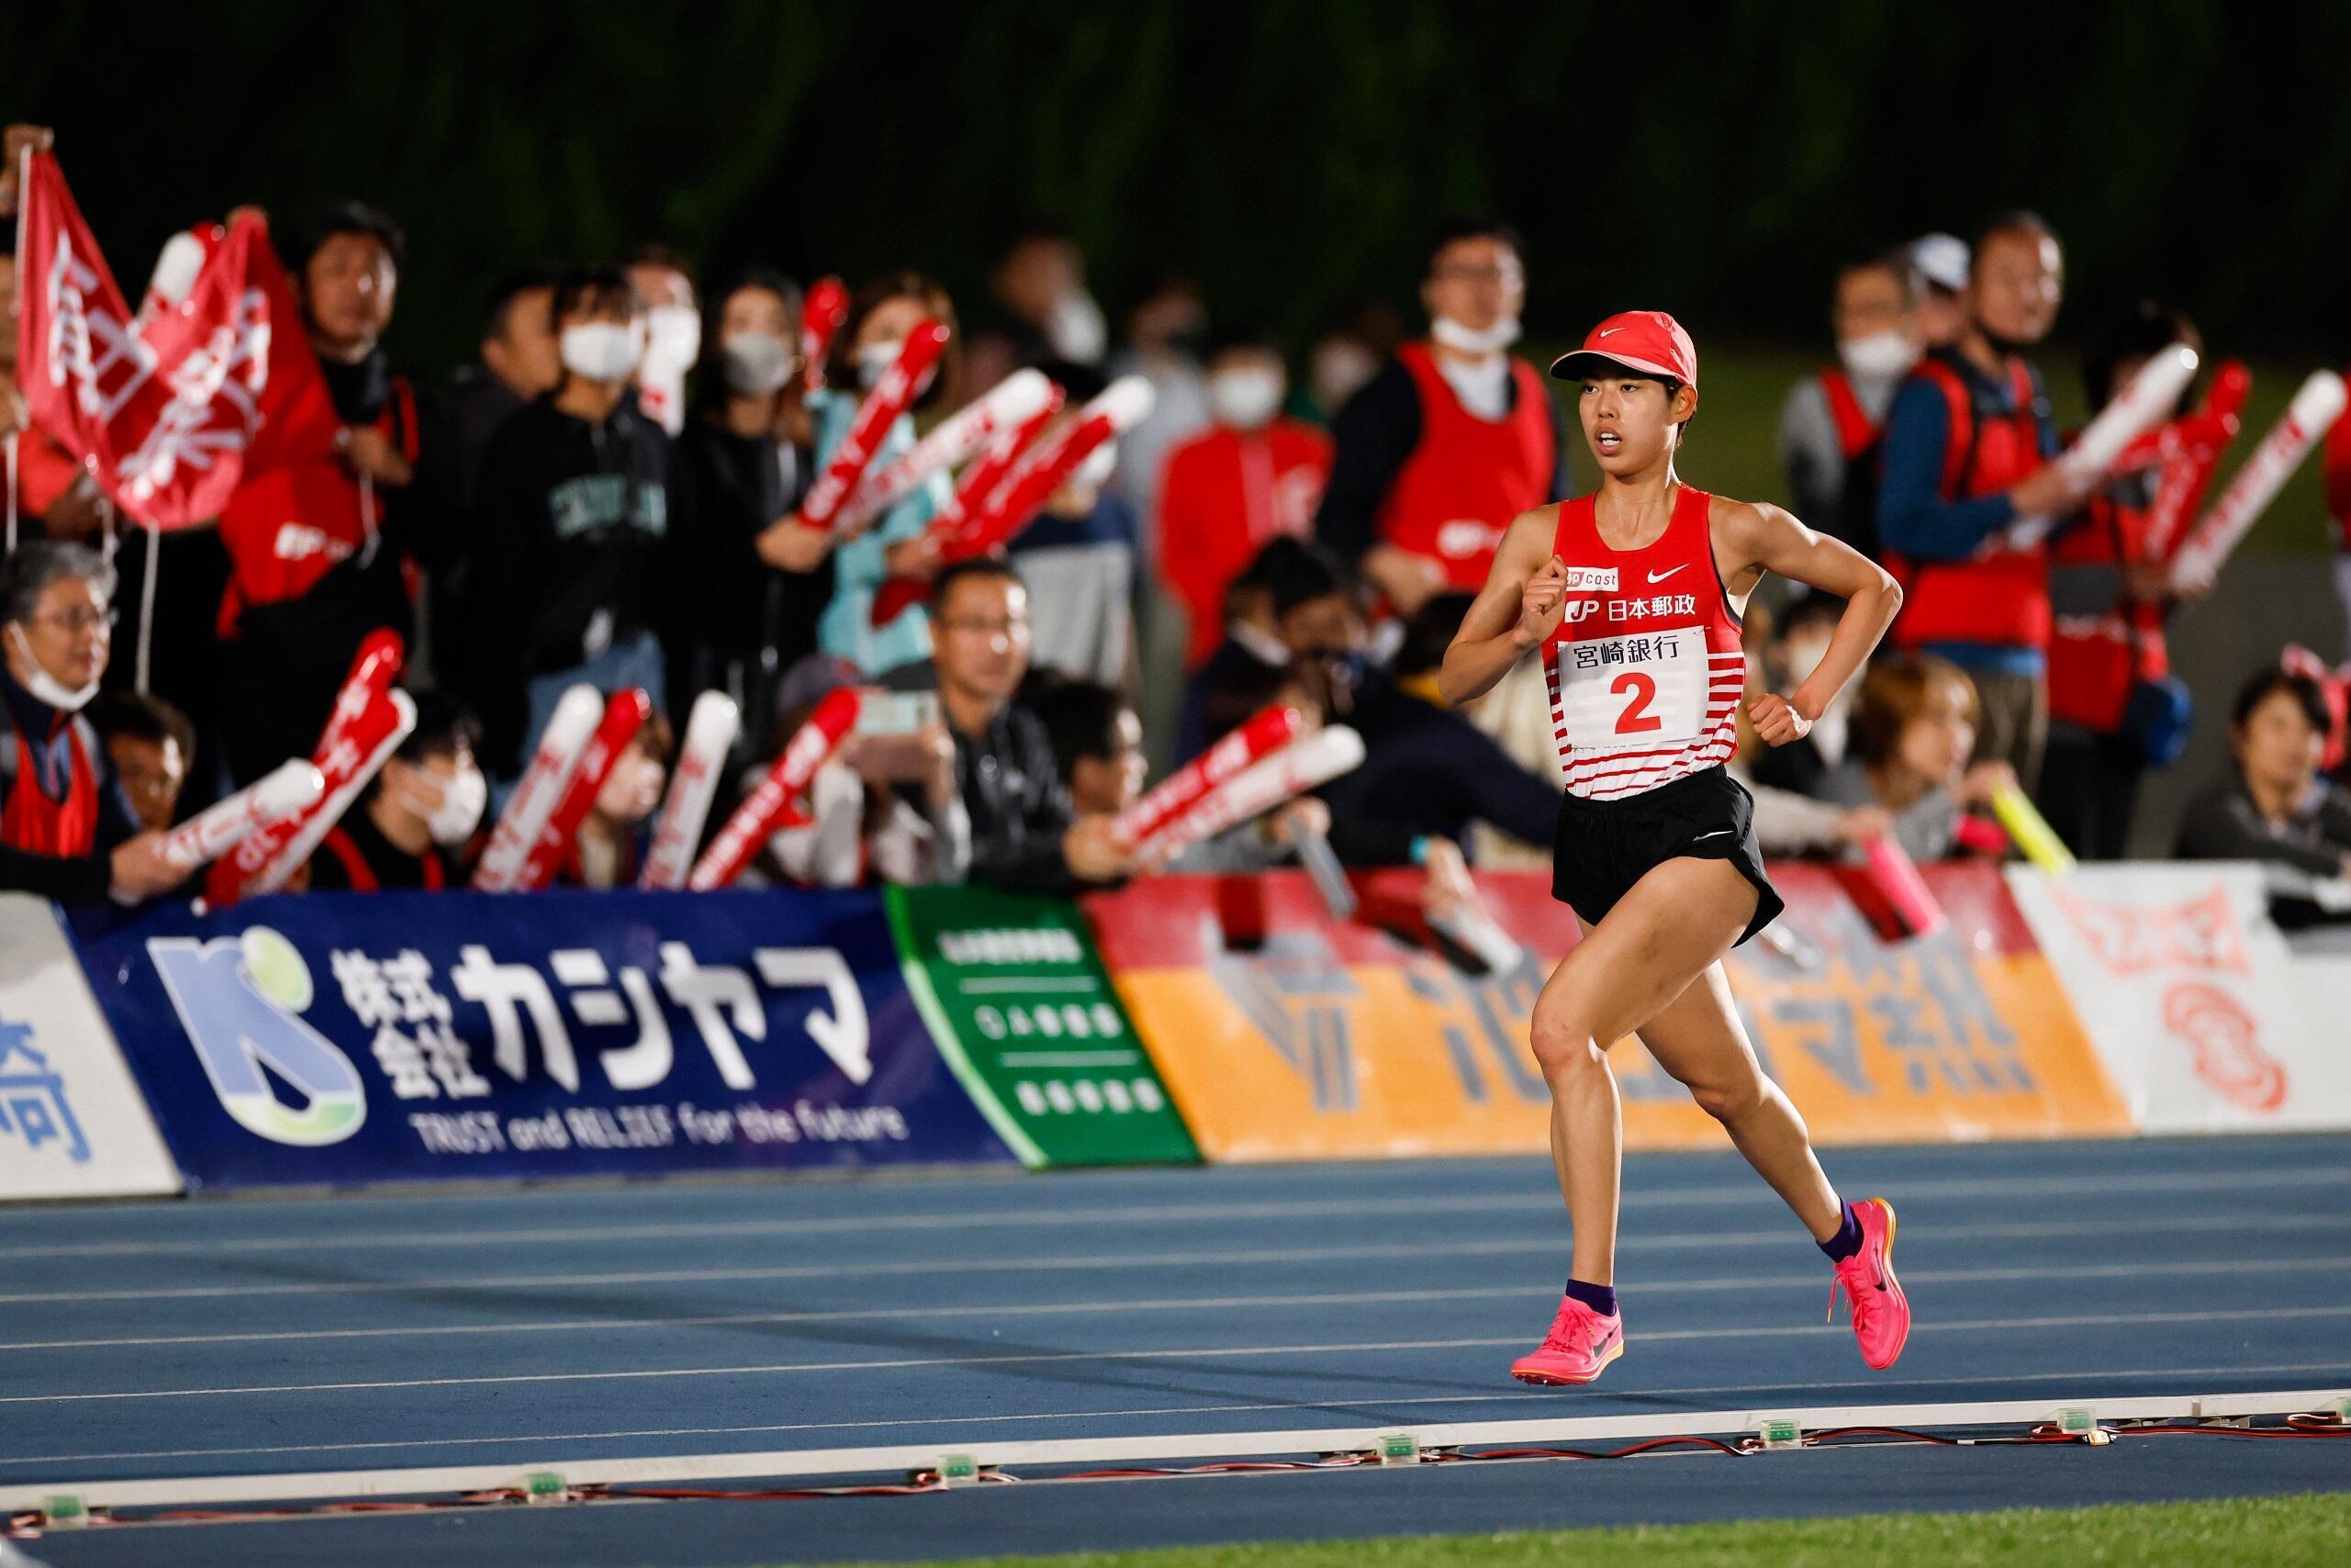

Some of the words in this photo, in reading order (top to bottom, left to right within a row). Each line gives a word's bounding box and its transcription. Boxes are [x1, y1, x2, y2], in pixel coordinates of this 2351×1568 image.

[1564, 599, 1600, 623] JP
[1608, 593, 1696, 622] 日本郵政
[1573, 634, 1679, 668] 宮崎銀行
[1610, 672, 1662, 734] 2
[449, 942, 873, 1093] カシヤマ
[408, 1111, 506, 1153] TRUST
[507, 1108, 571, 1151] and
[565, 1104, 675, 1149] RELIEF
[677, 1102, 734, 1145] for
[735, 1103, 801, 1144] the
[794, 1099, 911, 1141] future
